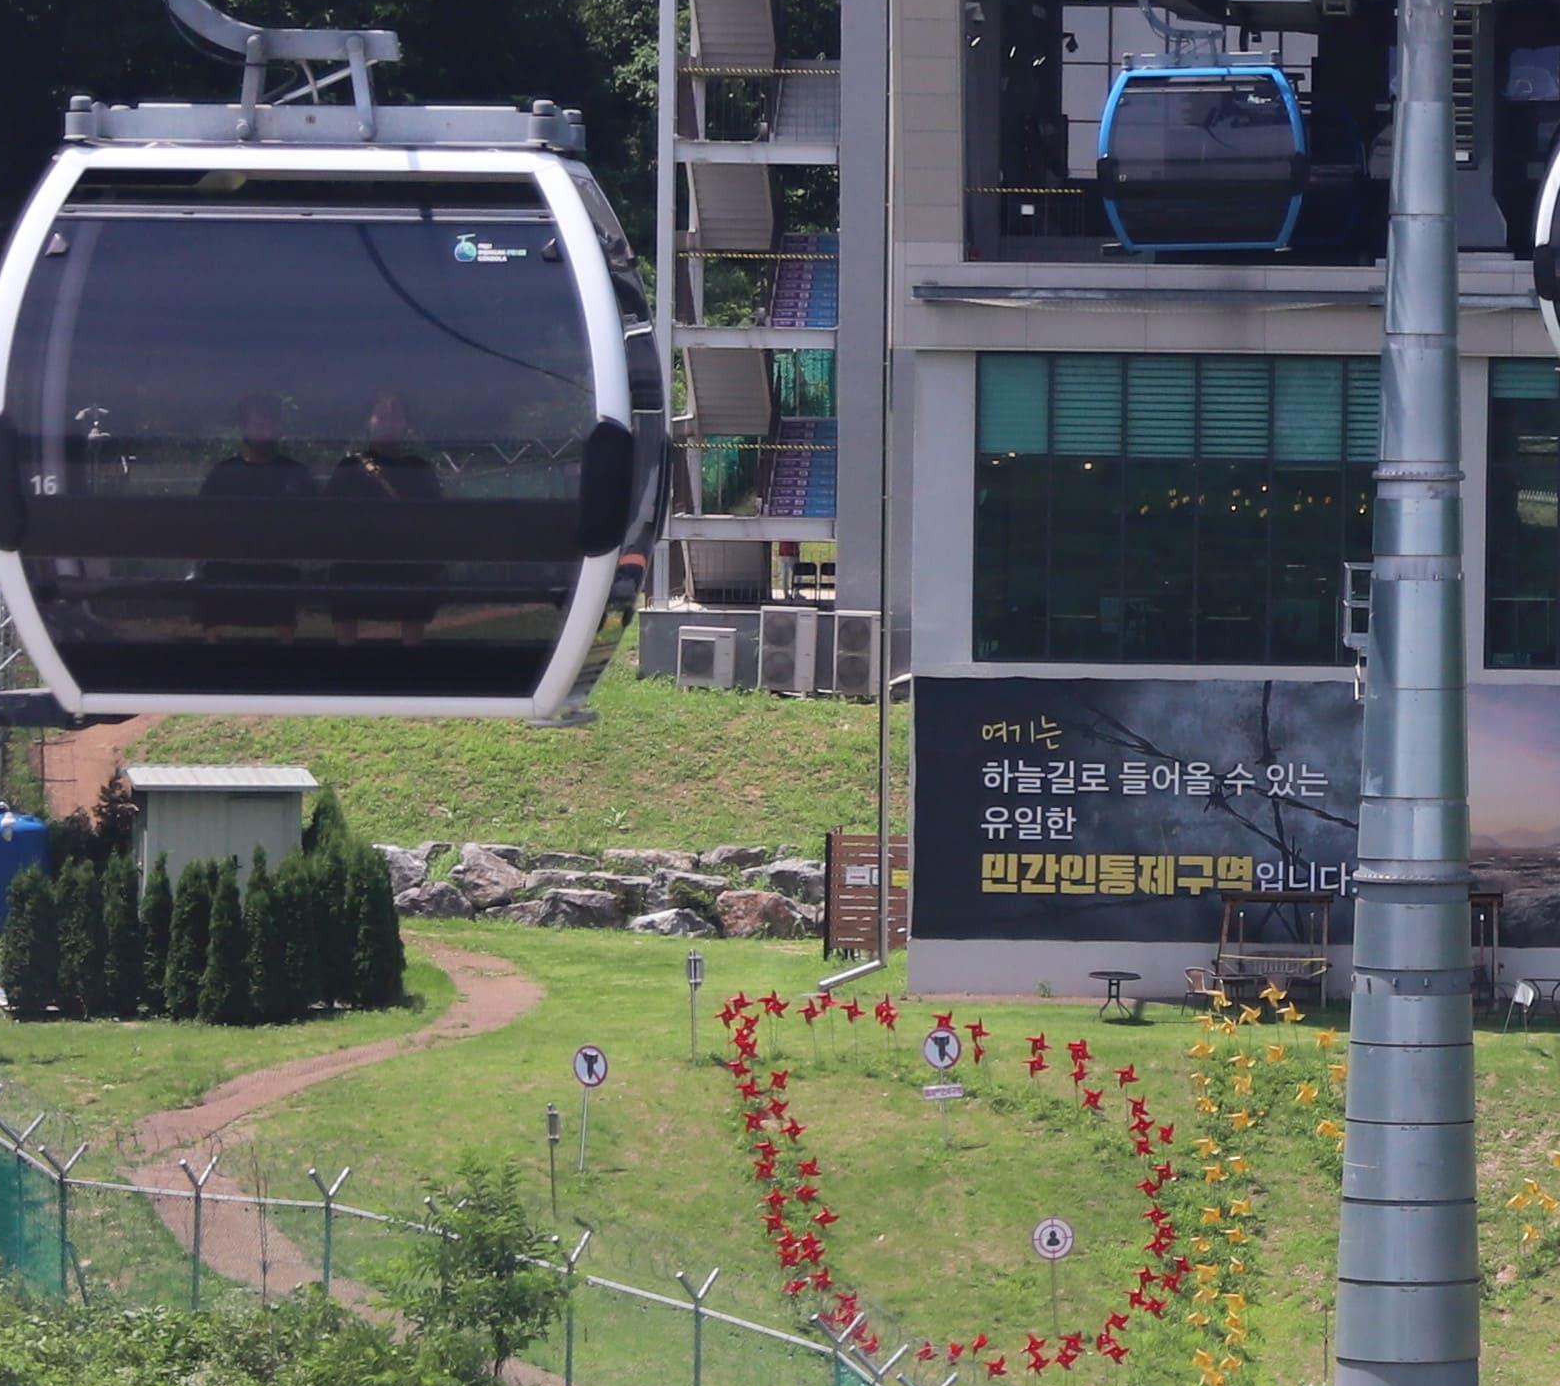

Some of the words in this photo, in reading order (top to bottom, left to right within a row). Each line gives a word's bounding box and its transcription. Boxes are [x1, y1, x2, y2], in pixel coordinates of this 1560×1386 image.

[30, 475, 57, 495] 16
[981, 715, 1062, 749] 여기는
[981, 759, 1110, 794] 하늘길로
[1118, 762, 1215, 796] 들어올
[1223, 763, 1256, 796] 수
[1266, 764, 1329, 797] 있는
[980, 807, 1078, 841] 유일한
